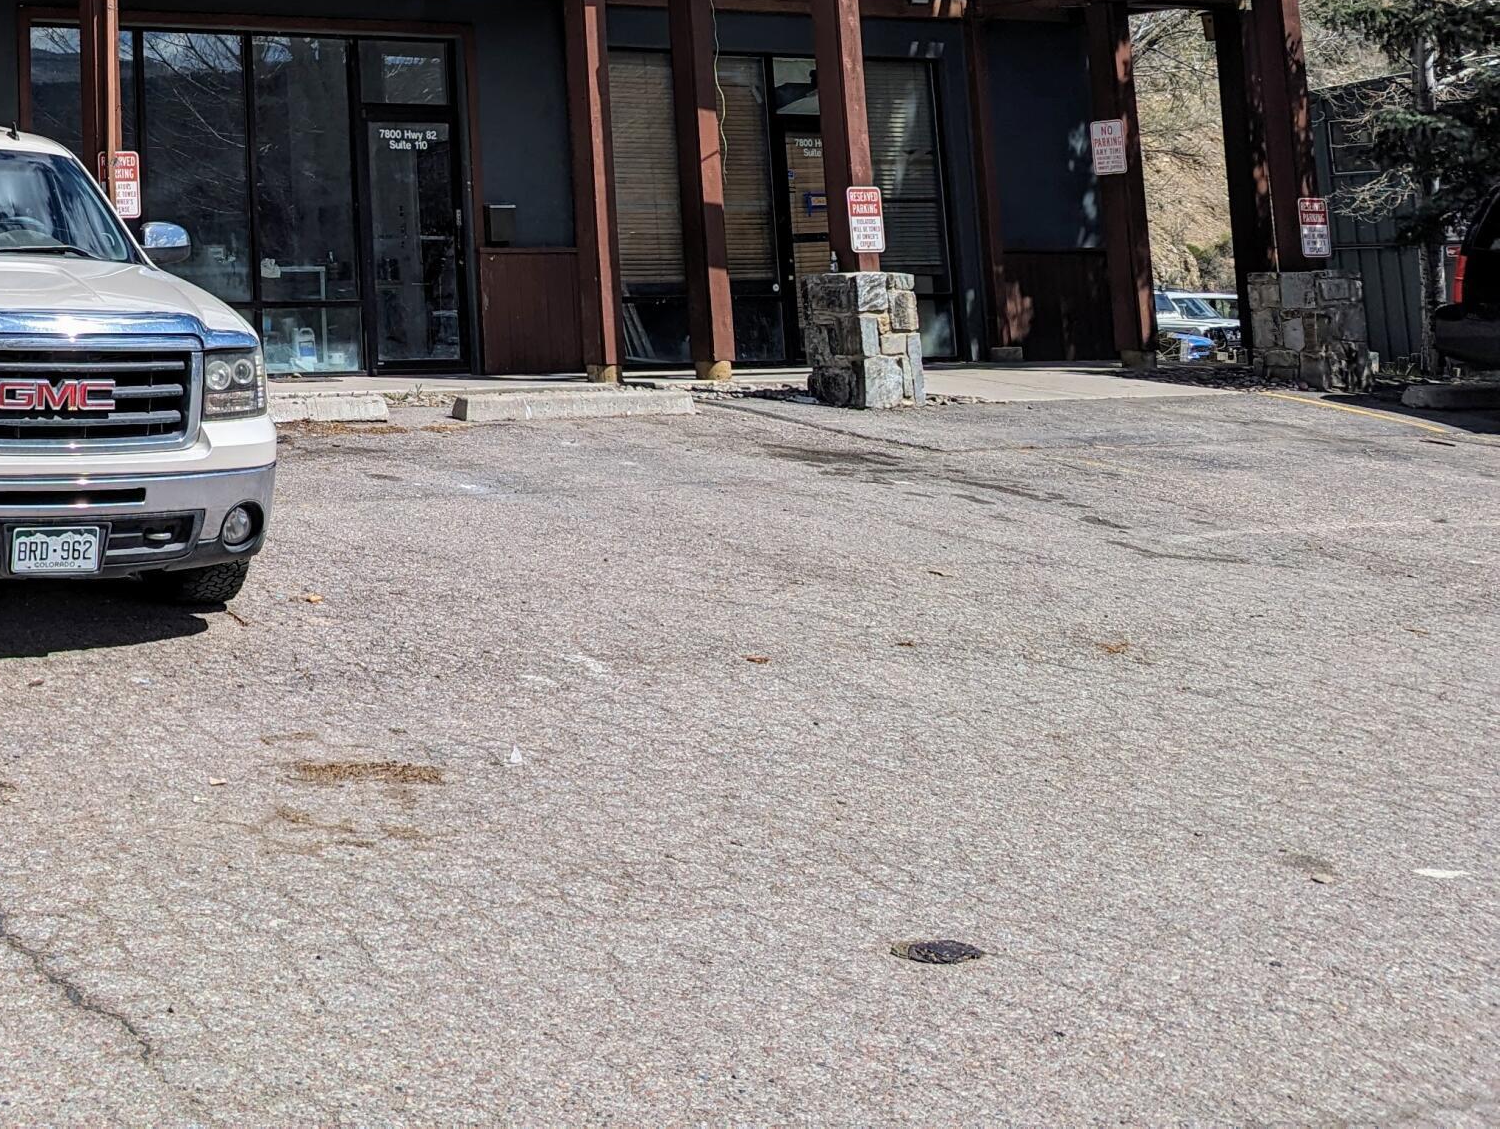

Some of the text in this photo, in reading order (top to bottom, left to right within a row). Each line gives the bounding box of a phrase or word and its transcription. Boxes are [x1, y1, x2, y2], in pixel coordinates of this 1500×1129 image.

[379, 129, 437, 141] 7800 Hwy 82
[1100, 125, 1113, 136] NO
[389, 140, 428, 150] Suite 110
[1093, 136, 1122, 148] PARKING
[849, 191, 878, 202] RESERVED
[852, 203, 878, 214] PARKING
